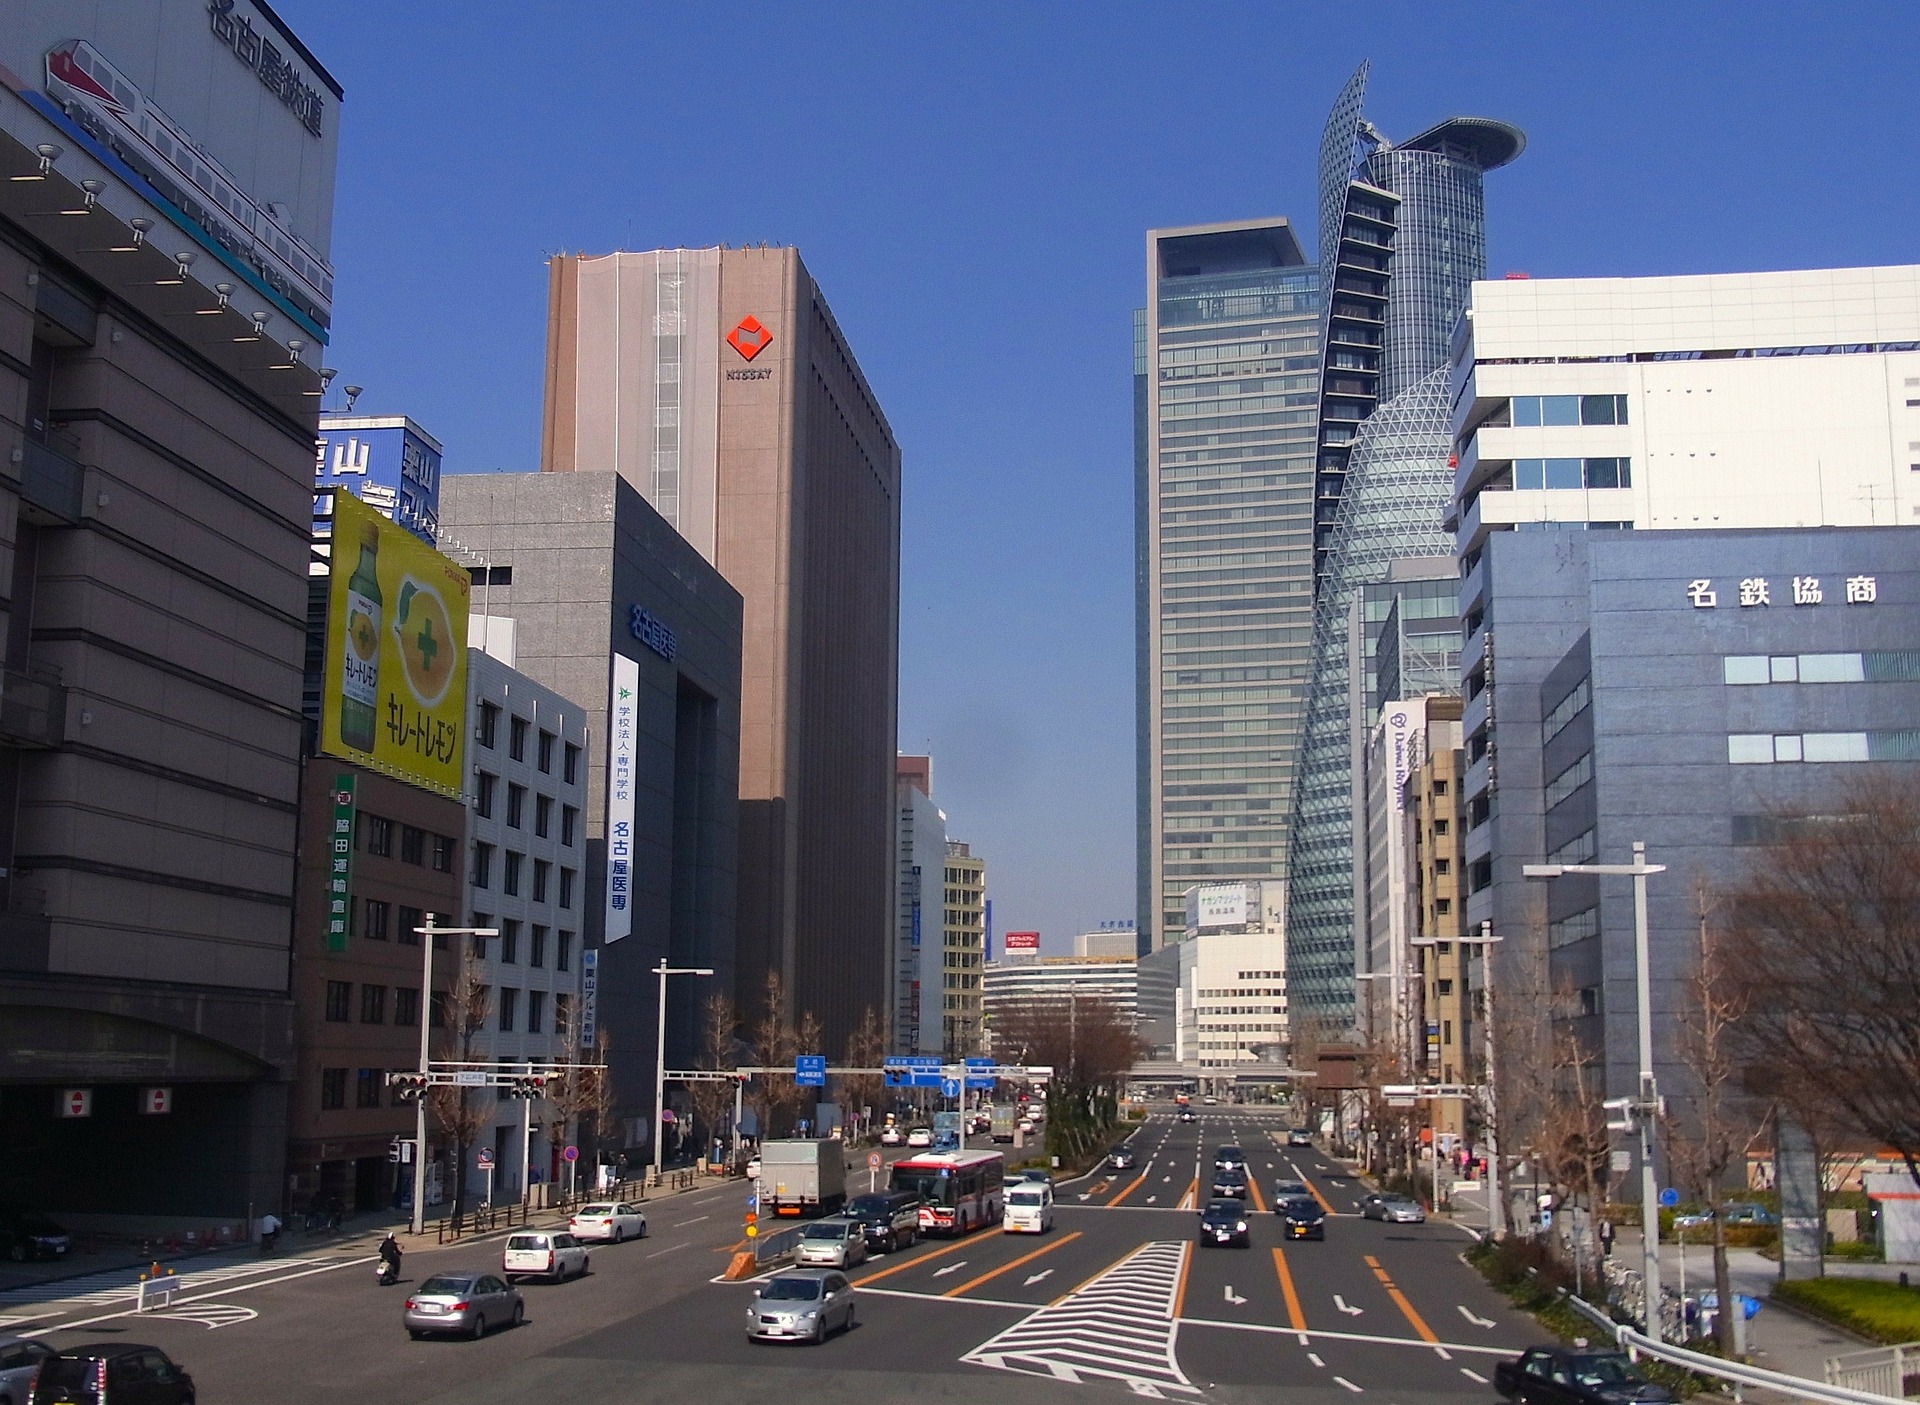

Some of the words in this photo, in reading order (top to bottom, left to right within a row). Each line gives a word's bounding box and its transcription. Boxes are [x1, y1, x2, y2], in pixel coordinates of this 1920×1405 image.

[726, 368, 772, 381] NISSAY
[1687, 575, 1877, 607] 名鉄協商
[633, 604, 677, 662] 名古屋医専
[386, 692, 457, 765] キレートレモン
[1394, 732, 1405, 768] Daiwa
[612, 821, 630, 911] 名古屋医専
